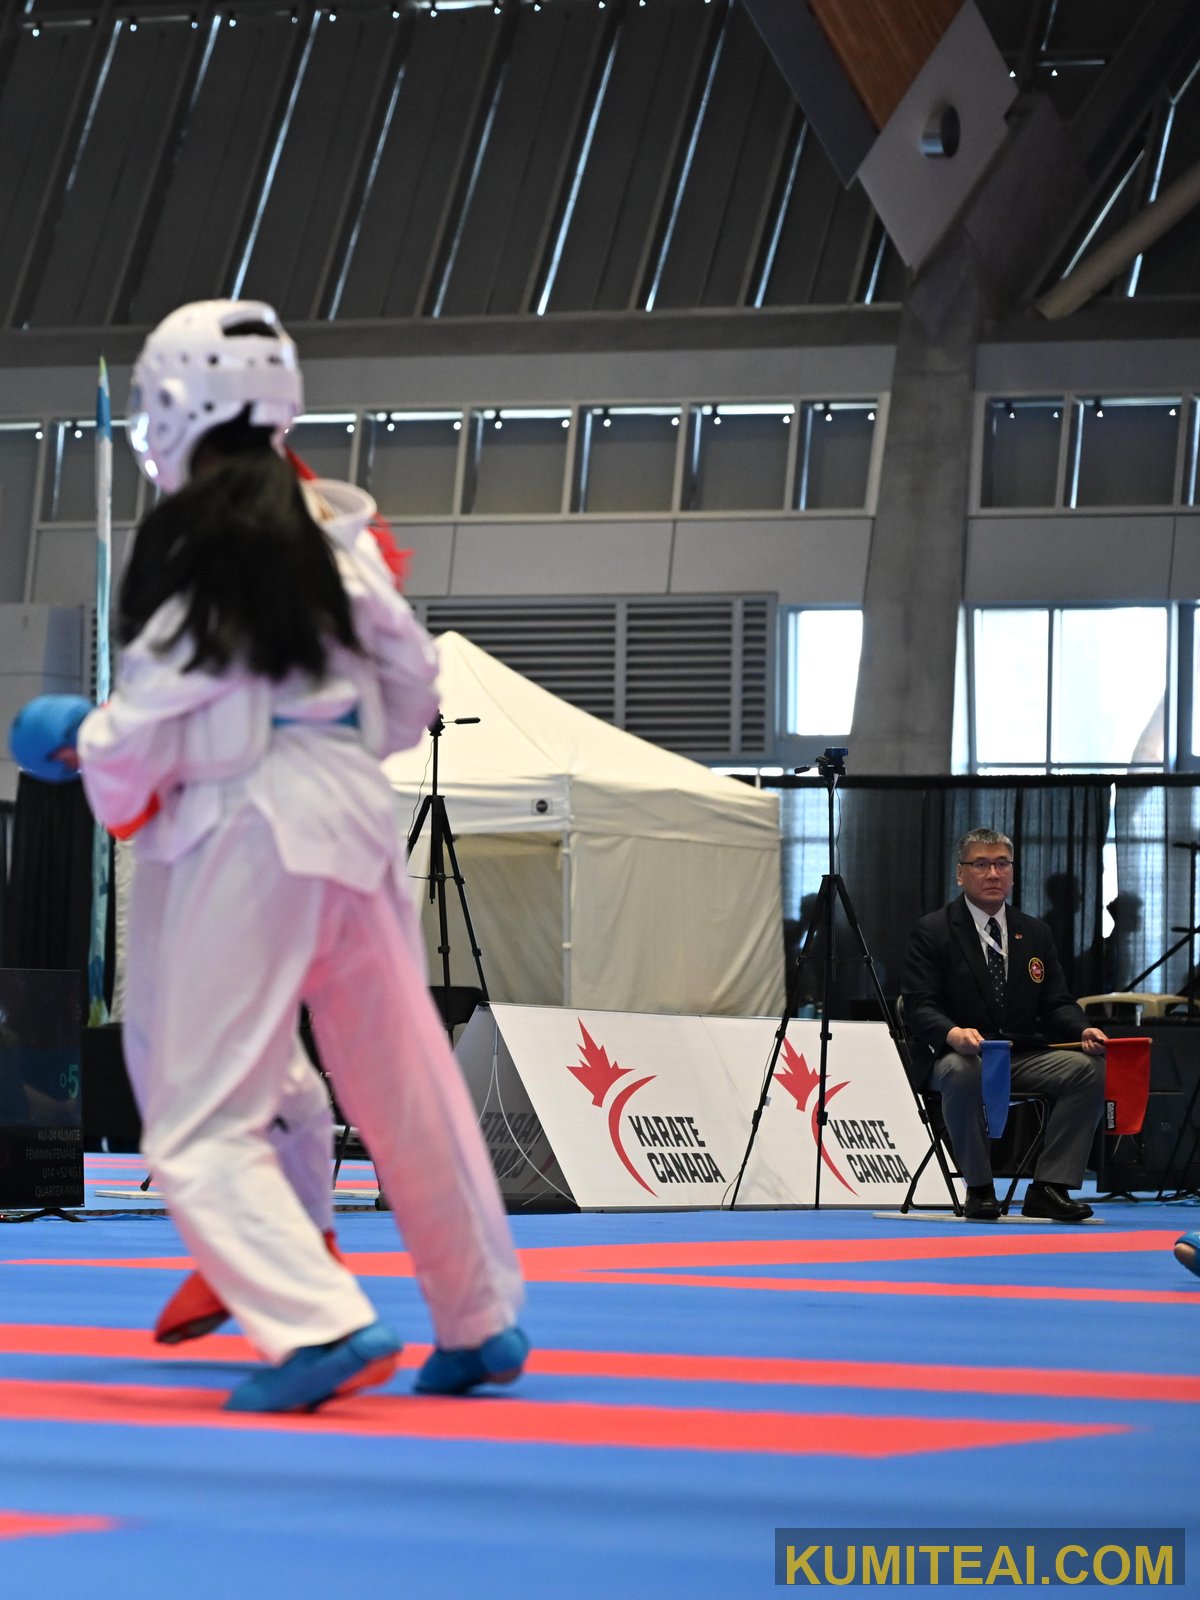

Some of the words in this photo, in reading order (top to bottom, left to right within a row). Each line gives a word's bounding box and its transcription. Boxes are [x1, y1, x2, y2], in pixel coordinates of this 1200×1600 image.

[627, 1115, 706, 1147] KARATE
[827, 1119, 896, 1149] KARATE
[647, 1152, 726, 1183] CANADA
[846, 1154, 913, 1183] CANADA
